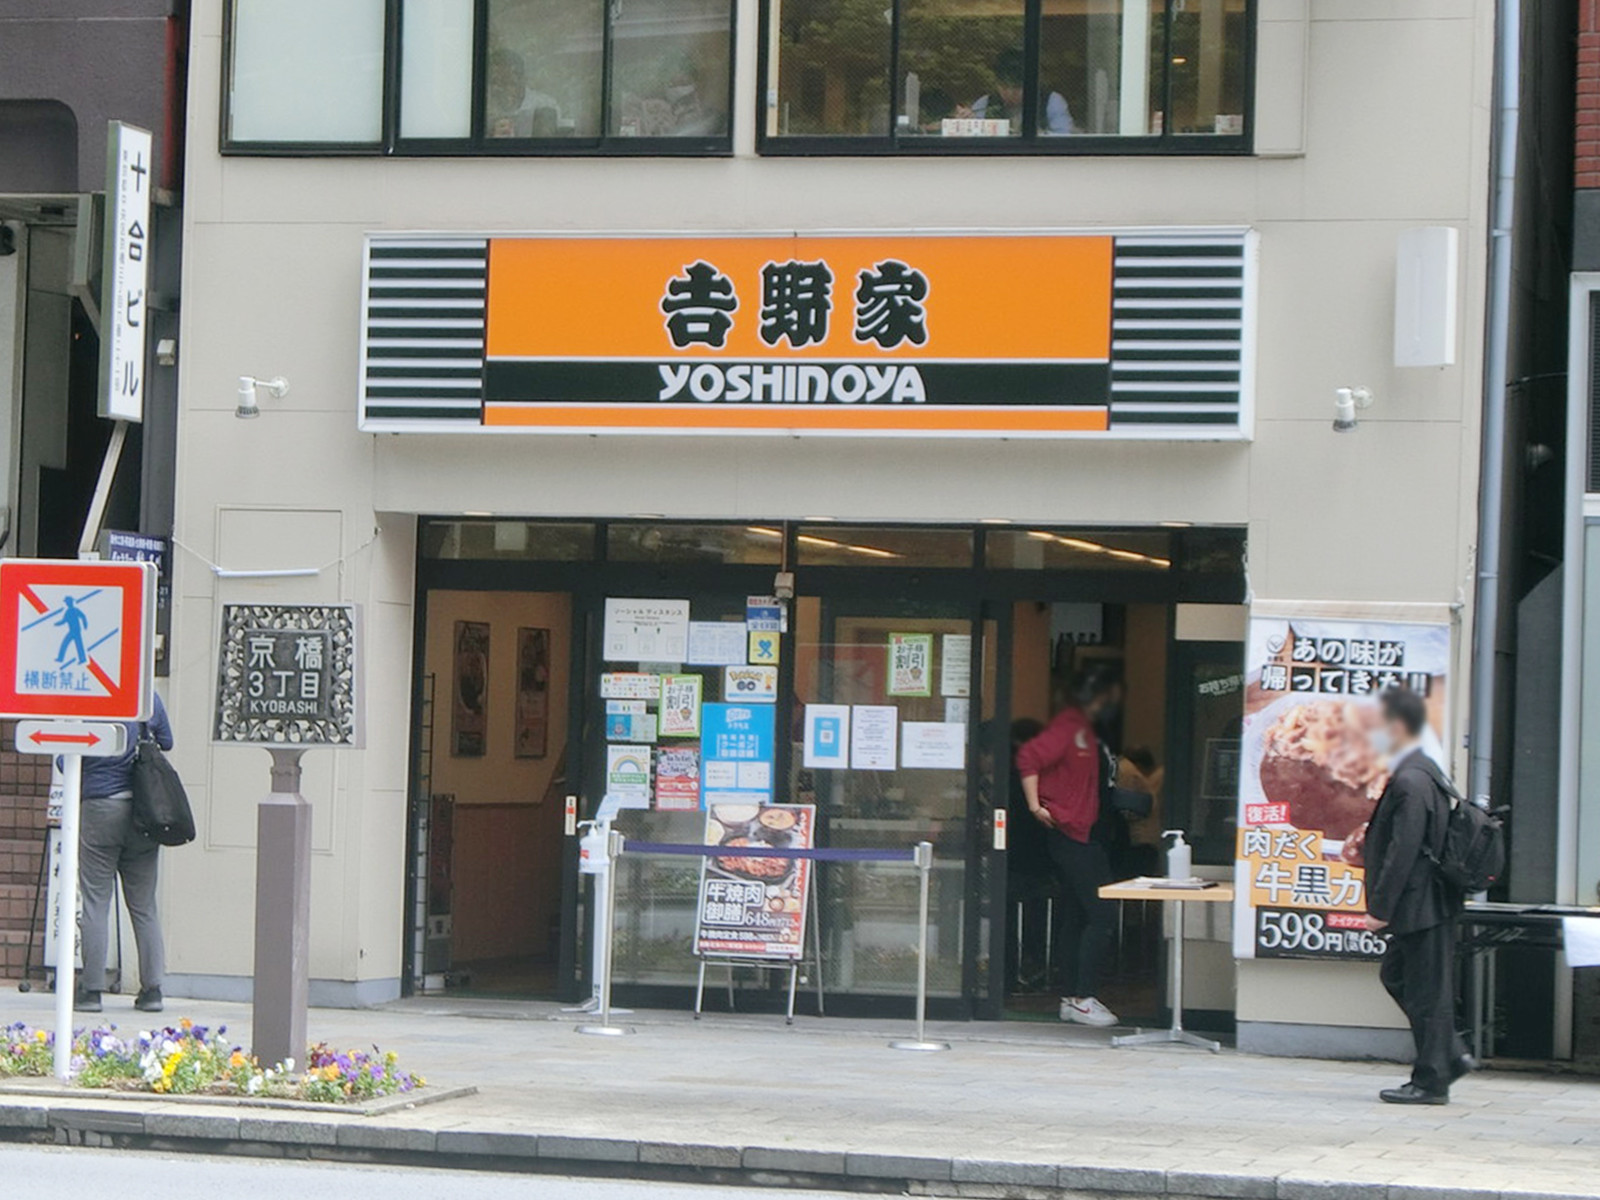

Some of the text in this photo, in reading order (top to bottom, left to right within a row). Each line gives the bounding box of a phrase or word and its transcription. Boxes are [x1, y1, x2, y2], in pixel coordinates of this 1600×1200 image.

[122, 151, 146, 396] 十合ビル
[660, 259, 929, 349] 吉野家
[658, 364, 927, 402] YOSHINOYA
[248, 635, 323, 670] 京橋
[895, 653, 925, 669] 割引
[1292, 638, 1404, 665] あの味が
[24, 670, 91, 692] 横断禁止
[248, 672, 319, 699] 3丁目
[250, 701, 318, 714] KYOBASHI
[666, 694, 695, 709] 割引
[1247, 805, 1287, 822] 復活!
[1242, 827, 1317, 860] 肉だく
[708, 883, 762, 902] 牛焼肉
